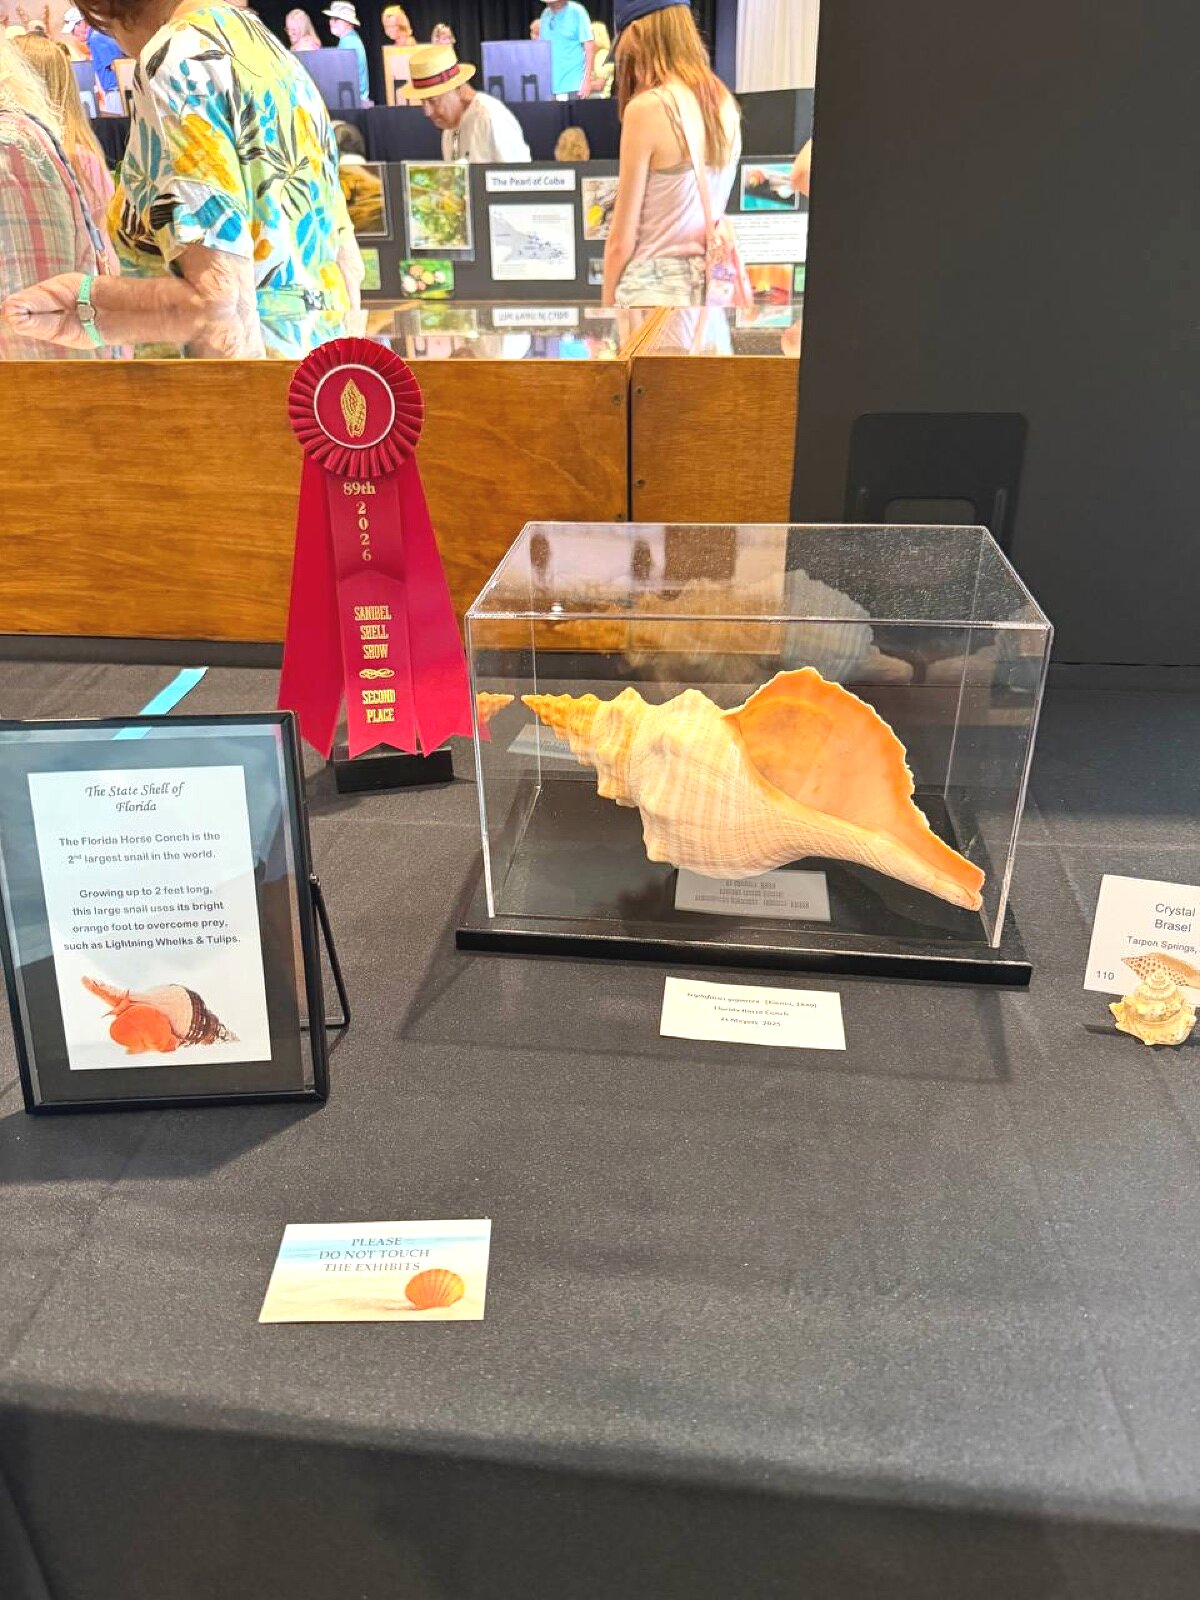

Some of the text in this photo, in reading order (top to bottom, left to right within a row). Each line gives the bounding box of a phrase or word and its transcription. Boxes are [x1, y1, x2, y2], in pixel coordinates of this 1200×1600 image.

[491, 176, 507, 186] The
[343, 481, 376, 496] 89th
[354, 605, 392, 621] SANIBEL
[360, 624, 389, 640] SHELL
[362, 643, 388, 660] SHOW
[362, 689, 396, 705] SECOND
[366, 707, 395, 723] PLACE
[85, 782, 185, 797] The State Shell of
[115, 799, 157, 812] Florida
[59, 831, 221, 846] The Florida Horse Conch is the
[84, 852, 122, 865] largest
[124, 851, 150, 862] snail
[151, 851, 161, 861] in
[163, 850, 181, 860] the
[183, 849, 217, 860] world.
[79, 888, 124, 900] Growing
[125, 888, 140, 899] up
[141, 887, 152, 896] to
[154, 886, 162, 896] 2
[163, 885, 185, 895] feet
[72, 900, 225, 918] this large snail uses its bright
[1155, 904, 1196, 917] Crystal
[72, 924, 110, 935] orange
[111, 922, 133, 932] foot
[134, 922, 146, 931] to
[147, 920, 199, 931] overcome
[1154, 919, 1192, 932] Brasel
[64, 934, 241, 951] such as Lightning Whelks & Tulips.
[1127, 936, 1198, 953] Tarpon Springs,
[1095, 970, 1115, 981] 110
[351, 1237, 402, 1247] PLEASE
[319, 1248, 430, 1260] DO NOT TOUCH
[324, 1261, 421, 1272] THE EXHIBITS
